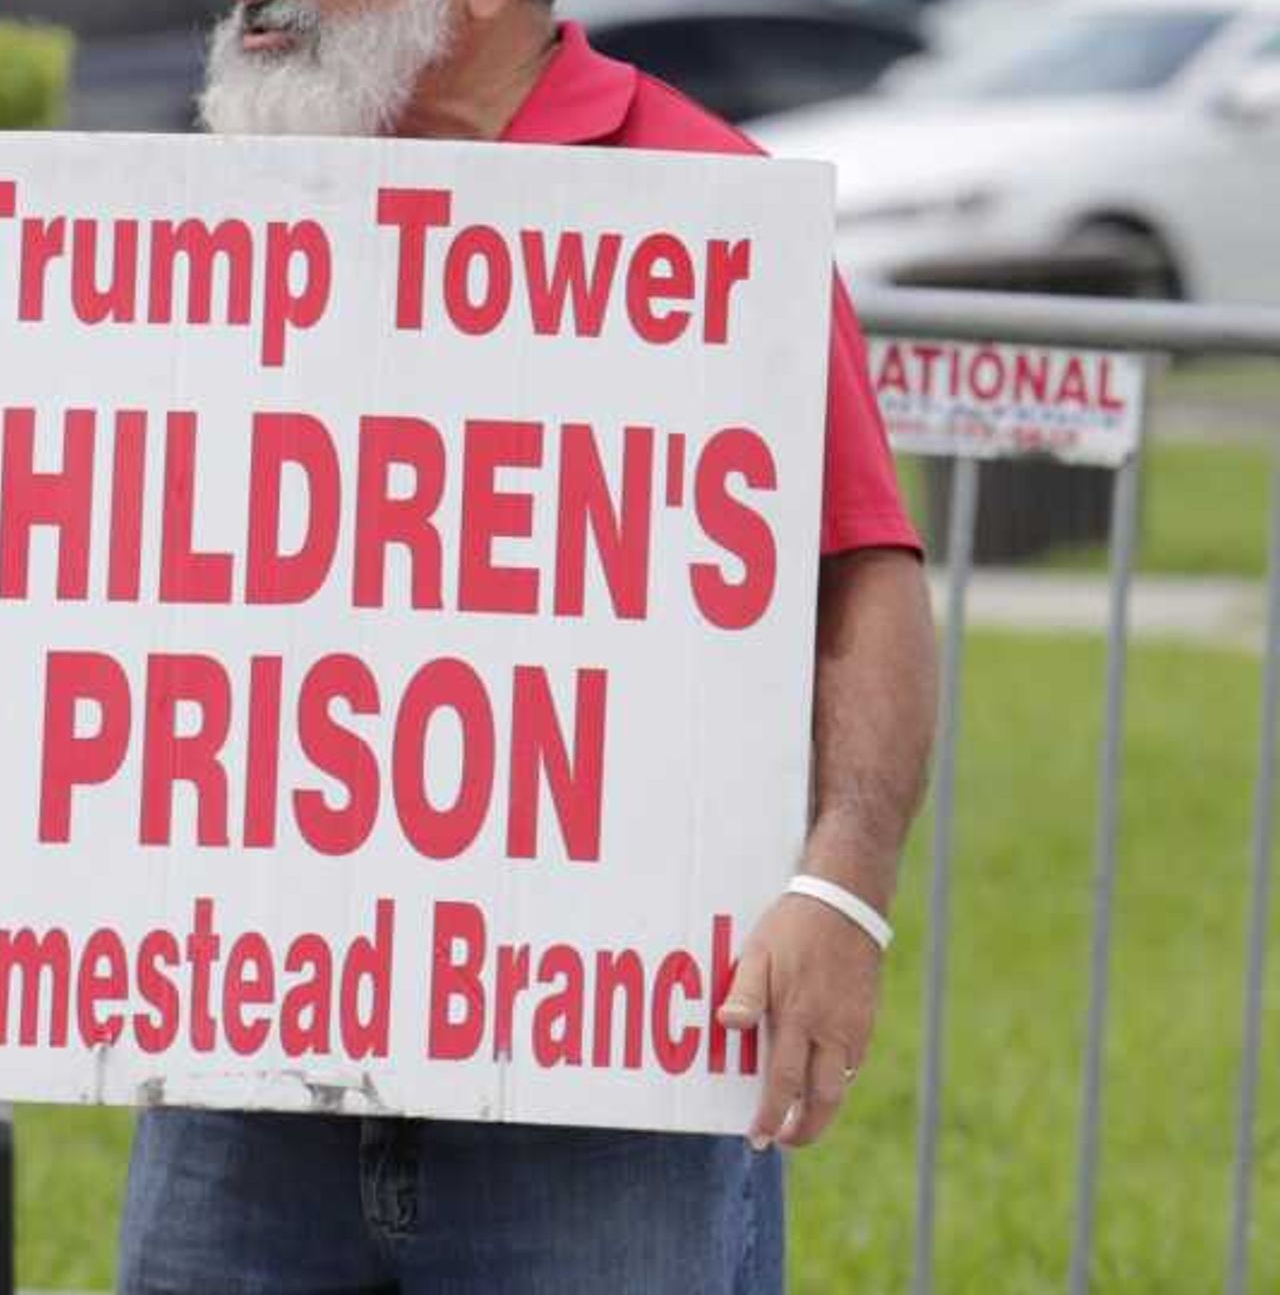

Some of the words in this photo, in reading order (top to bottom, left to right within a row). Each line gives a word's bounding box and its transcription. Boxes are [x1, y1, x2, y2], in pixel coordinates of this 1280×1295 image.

[378, 190, 751, 343] Tower
[41, 653, 607, 859] PRISON
[431, 903, 753, 1073] Branch
